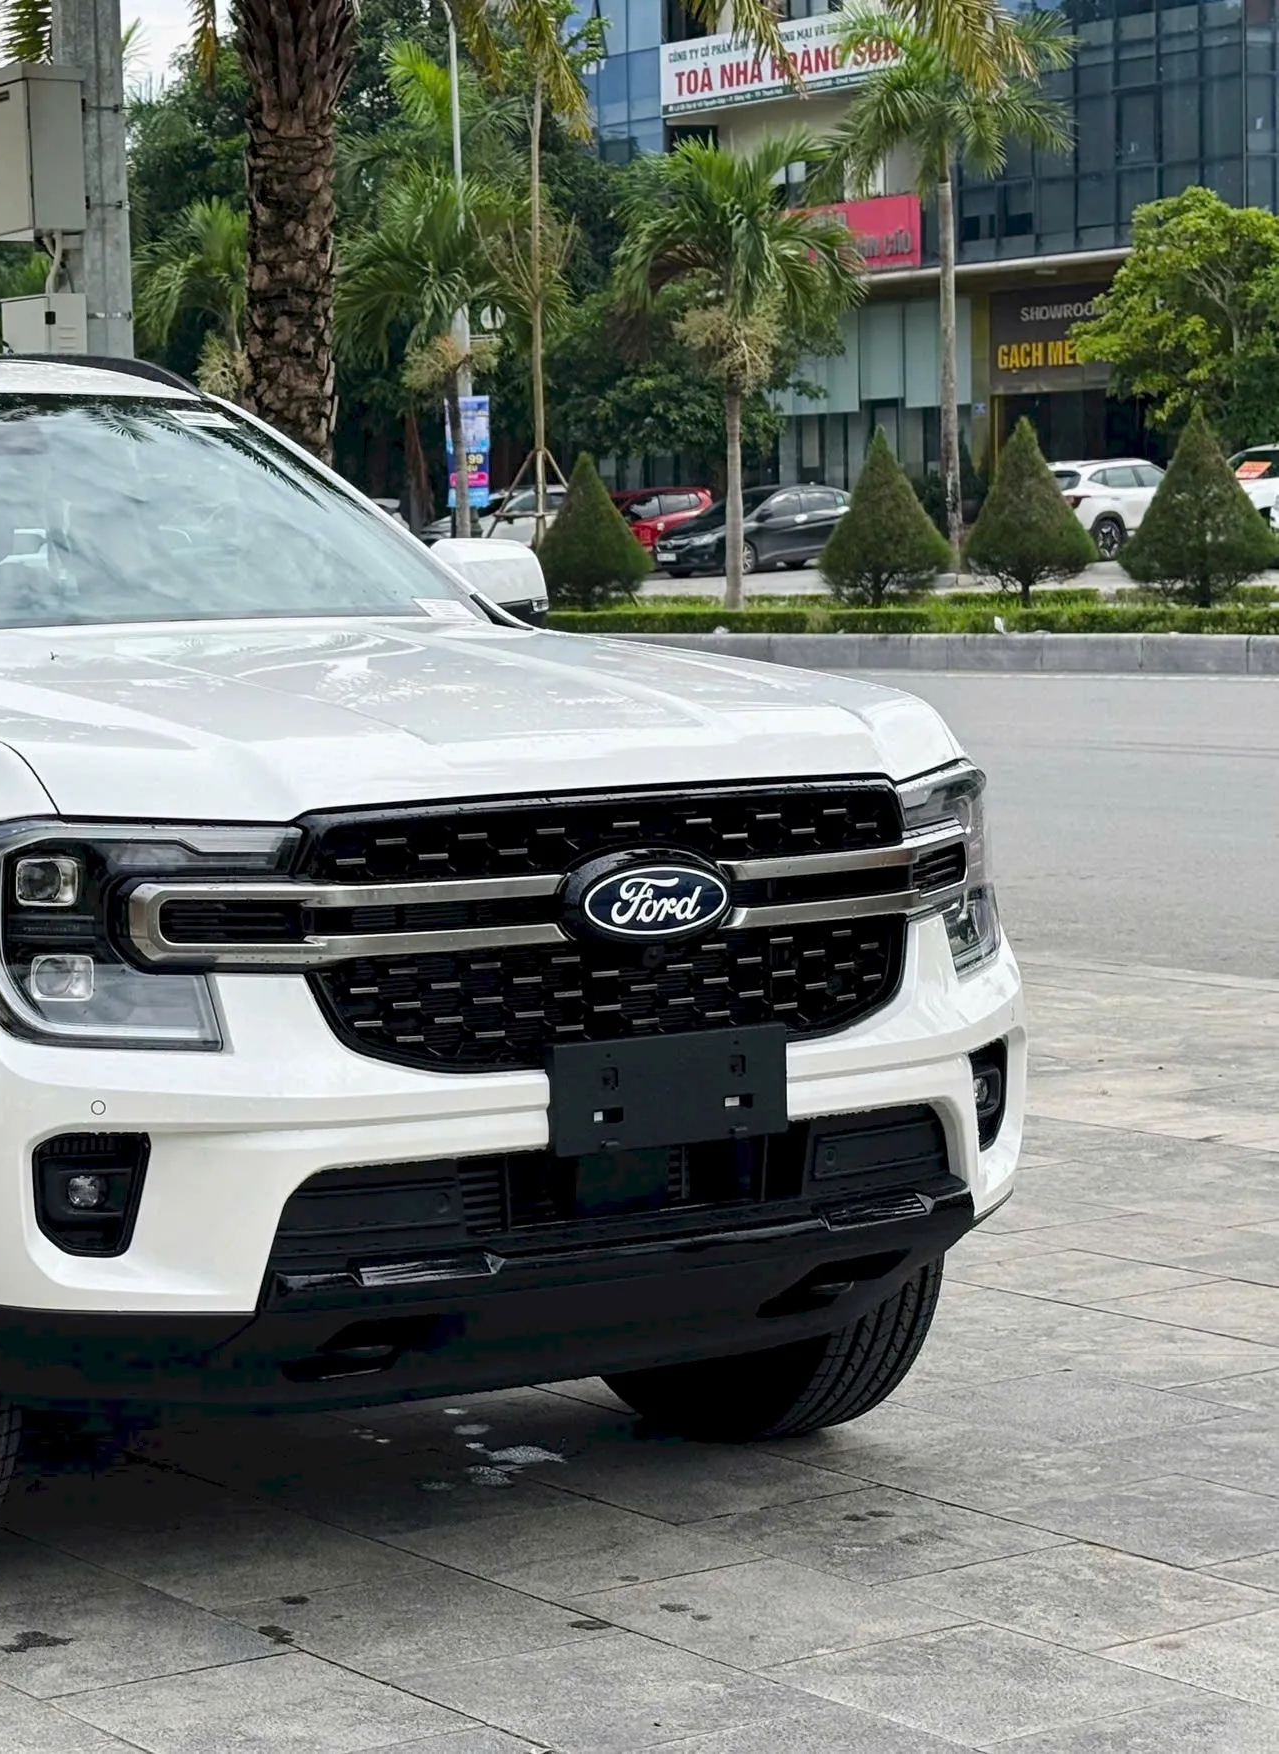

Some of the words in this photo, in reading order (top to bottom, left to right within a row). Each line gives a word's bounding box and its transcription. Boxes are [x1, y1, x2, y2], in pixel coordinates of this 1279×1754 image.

[689, 48, 700, 60] TY
[674, 61, 714, 97] TOÀ
[997, 341, 1043, 374] GẠCH
[1047, 339, 1084, 367] ME
[611, 876, 703, 925] Ford
